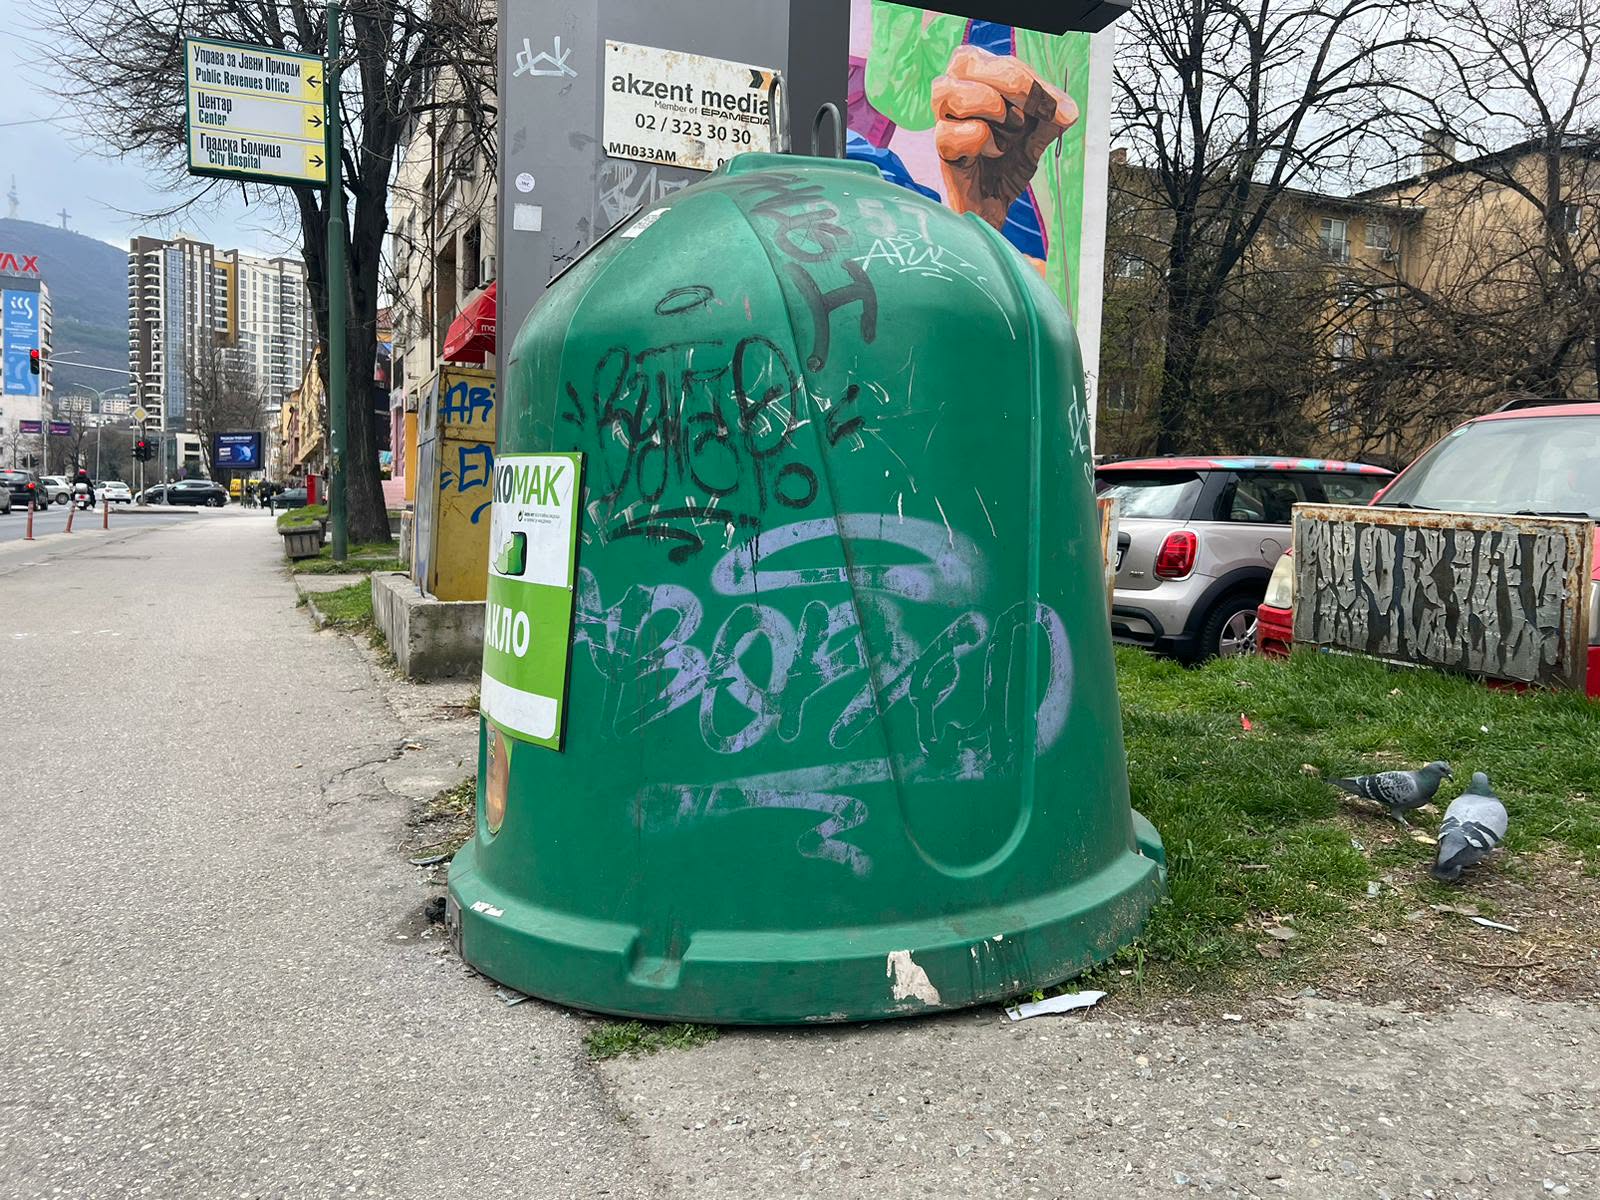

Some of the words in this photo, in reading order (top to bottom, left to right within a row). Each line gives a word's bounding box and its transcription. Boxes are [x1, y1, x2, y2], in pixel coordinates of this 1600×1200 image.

[193, 45, 224, 66] Управа
[226, 55, 236, 68] за
[238, 53, 263, 71] Јавни
[265, 57, 300, 77] Приходи
[195, 67, 222, 84] Public
[223, 71, 263, 91] Revenues
[265, 77, 290, 93] Office
[197, 92, 232, 113] Центар
[611, 73, 694, 104] akzent
[701, 90, 770, 116] media
[198, 109, 227, 126] Center
[654, 100, 687, 113] Member
[688, 106, 698, 115] of
[701, 107, 771, 126] EPAMEDIA
[635, 113, 656, 130] 02
[660, 116, 668, 132] /
[671, 119, 702, 137] 323
[707, 124, 727, 141] 30
[731, 128, 751, 145] 30
[200, 133, 239, 153] Градска
[240, 138, 281, 158] Болница
[208, 150, 226, 166] City
[227, 151, 261, 169] Hospital
[0, 252, 39, 273] AX
[484, 600, 530, 658] АКЛО
